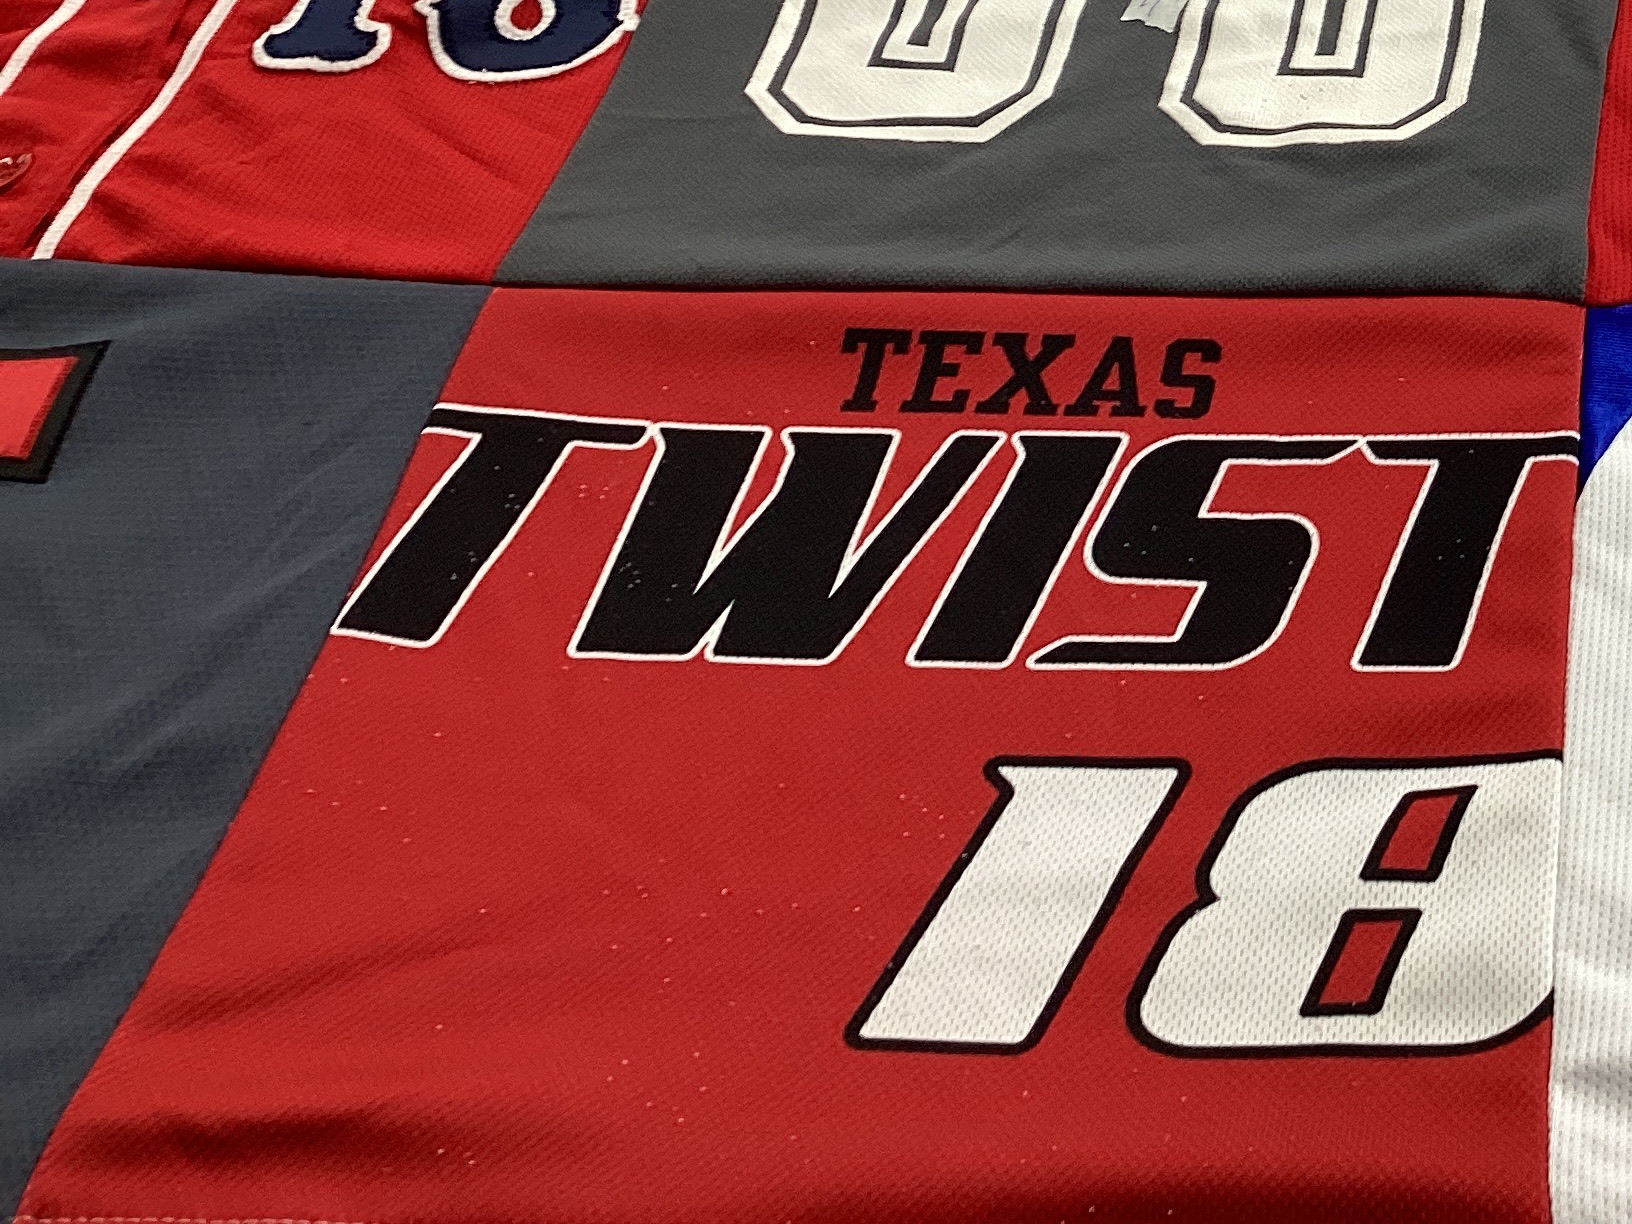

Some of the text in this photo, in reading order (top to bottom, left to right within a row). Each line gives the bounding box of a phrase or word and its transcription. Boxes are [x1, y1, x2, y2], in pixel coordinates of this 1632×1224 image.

[840, 327, 1222, 419] TEXAS
[329, 402, 1580, 672] TWIST
[843, 754, 1562, 1056] 18
